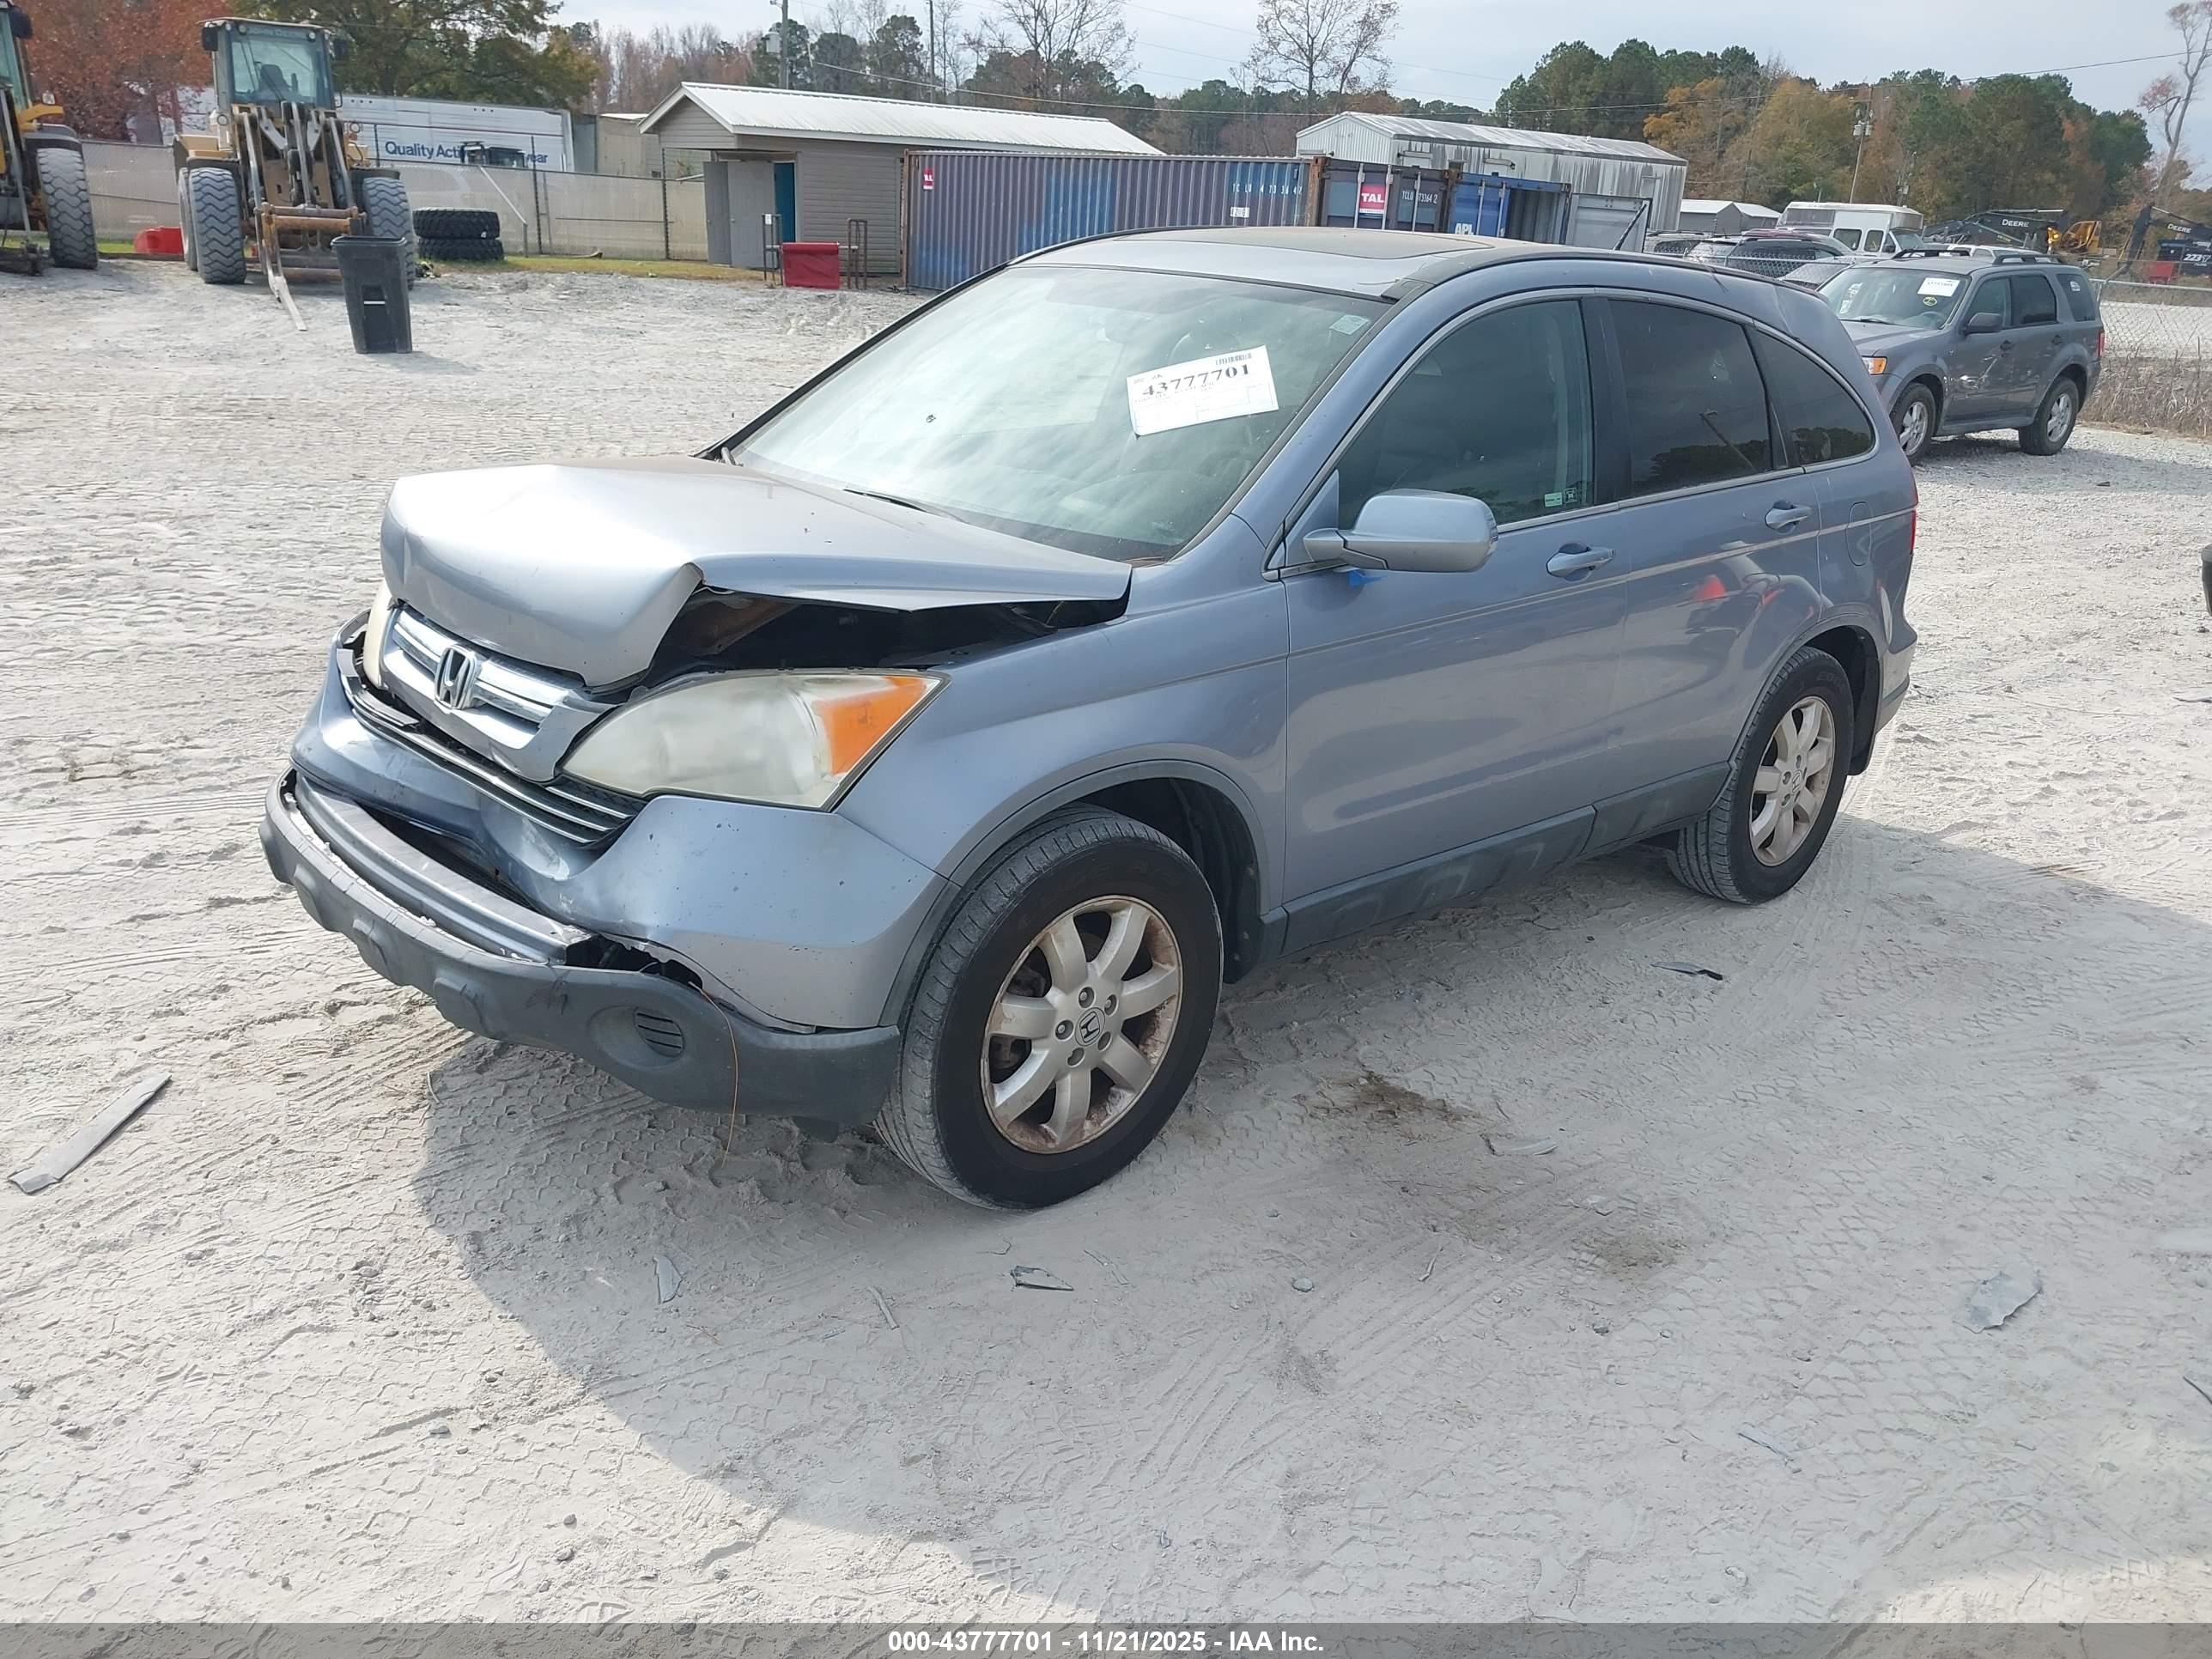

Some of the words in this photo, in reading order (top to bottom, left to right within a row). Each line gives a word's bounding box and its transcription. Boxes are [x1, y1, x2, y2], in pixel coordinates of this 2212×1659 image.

[386, 141, 434, 159] Quality
[1361, 192, 1384, 204] TAL
[1455, 222, 1474, 235] APL
[2002, 219, 2030, 228] DEERE
[2167, 223, 2191, 233] DEERE
[1142, 364, 1249, 396] 43777701
